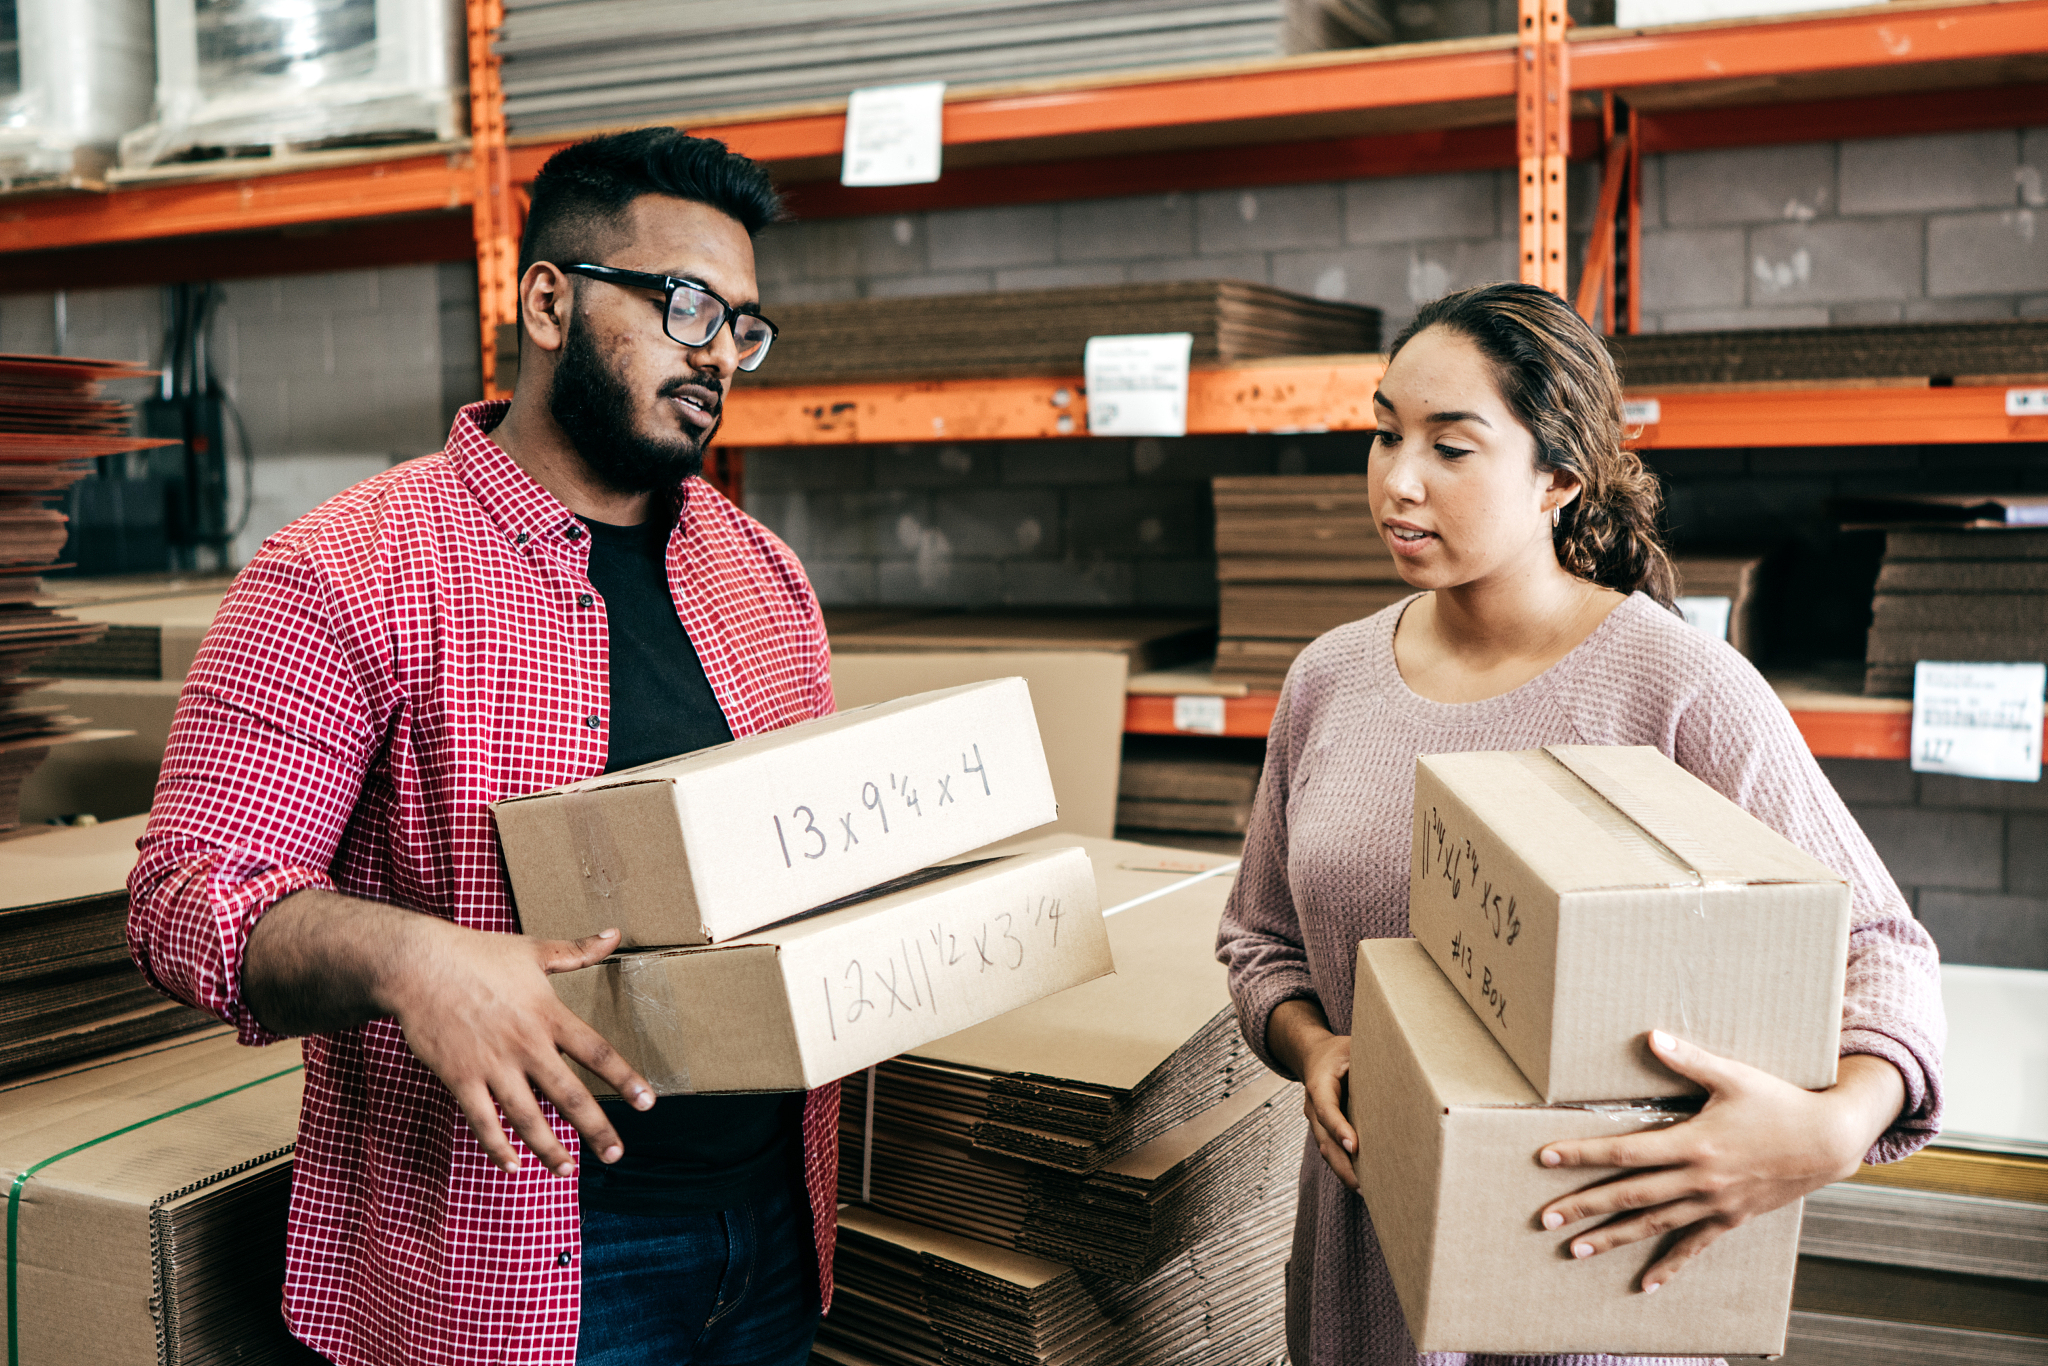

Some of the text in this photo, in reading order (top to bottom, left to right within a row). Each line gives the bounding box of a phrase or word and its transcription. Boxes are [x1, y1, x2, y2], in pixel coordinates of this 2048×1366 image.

[773, 805, 828, 869] 13
[961, 742, 991, 797] 4
[1451, 930, 1473, 980] #13
